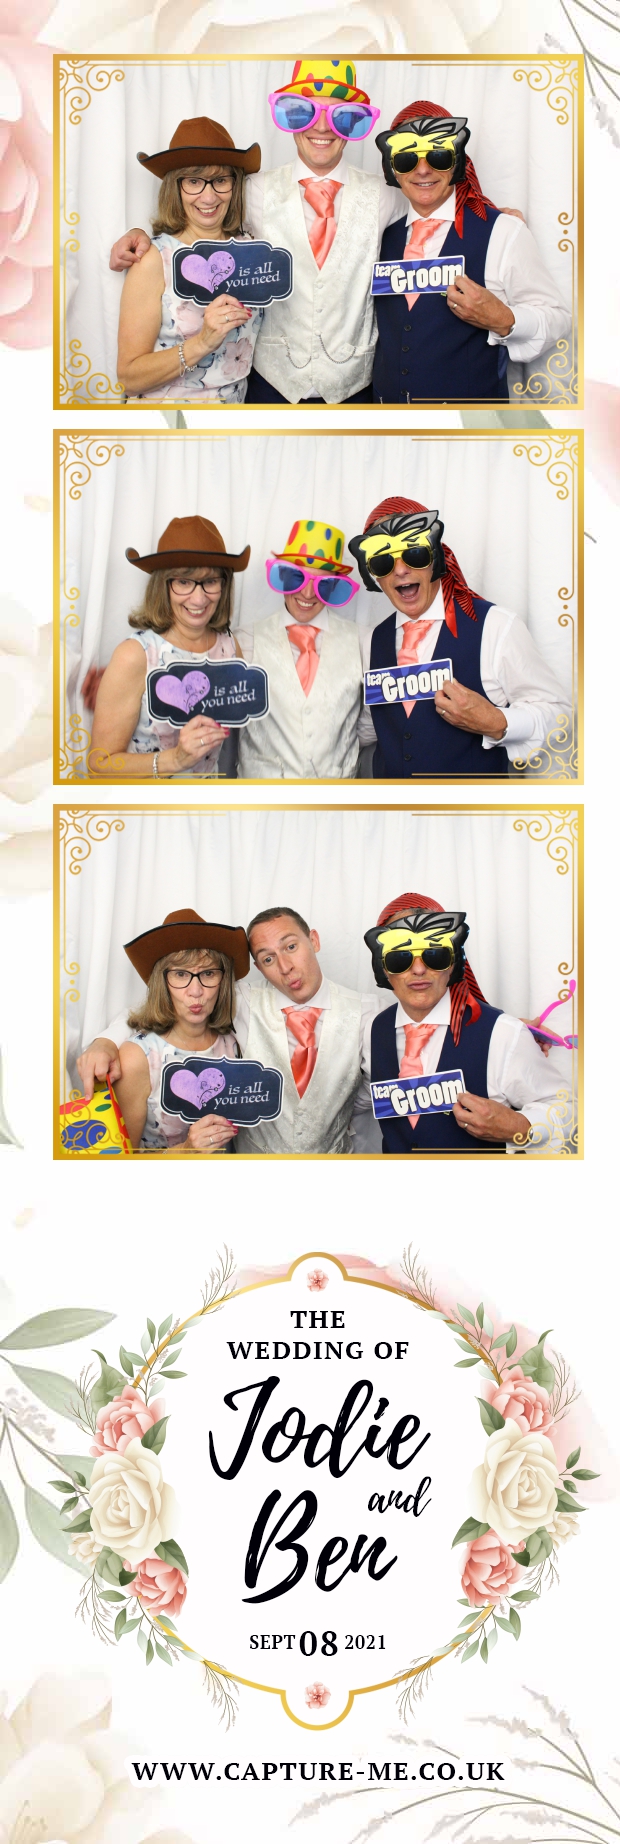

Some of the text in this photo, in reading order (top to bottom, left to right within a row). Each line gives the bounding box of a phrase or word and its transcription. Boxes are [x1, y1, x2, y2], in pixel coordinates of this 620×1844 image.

[238, 261, 274, 277] is all
[390, 264, 462, 293] Groom
[225, 270, 281, 292] you need
[214, 680, 249, 697] is all
[381, 668, 450, 702] Groom
[201, 689, 257, 713] you need
[228, 1081, 264, 1095] is all
[390, 1079, 462, 1116] Groom
[213, 1090, 270, 1110] you need
